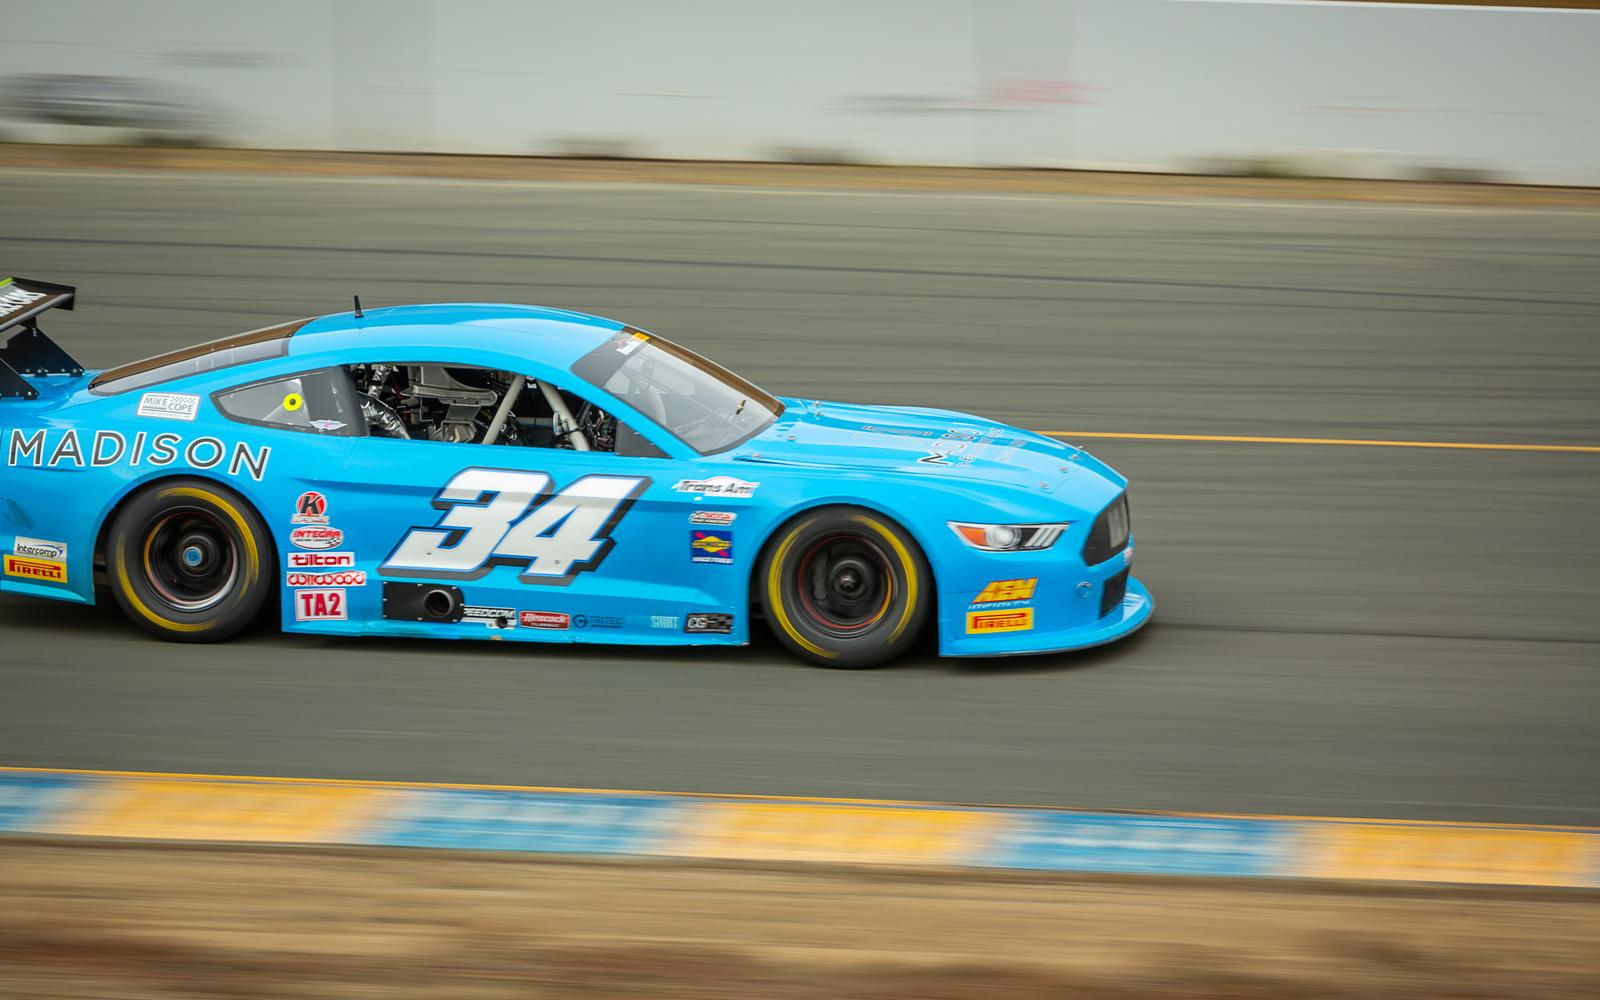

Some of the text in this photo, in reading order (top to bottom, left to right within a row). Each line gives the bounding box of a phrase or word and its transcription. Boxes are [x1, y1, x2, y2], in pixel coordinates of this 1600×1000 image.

[144, 397, 168, 406] MIKE
[168, 402, 193, 412] COPE
[8, 429, 271, 481] MADISON
[300, 495, 323, 515] K
[380, 466, 651, 582] 34
[17, 543, 58, 558] Intercomp
[9, 559, 62, 578] PIRELLI
[292, 554, 350, 566] tilton
[301, 592, 342, 617] TA2
[463, 607, 514, 619] PEEDCOM
[972, 612, 1026, 629] PIRELLI
